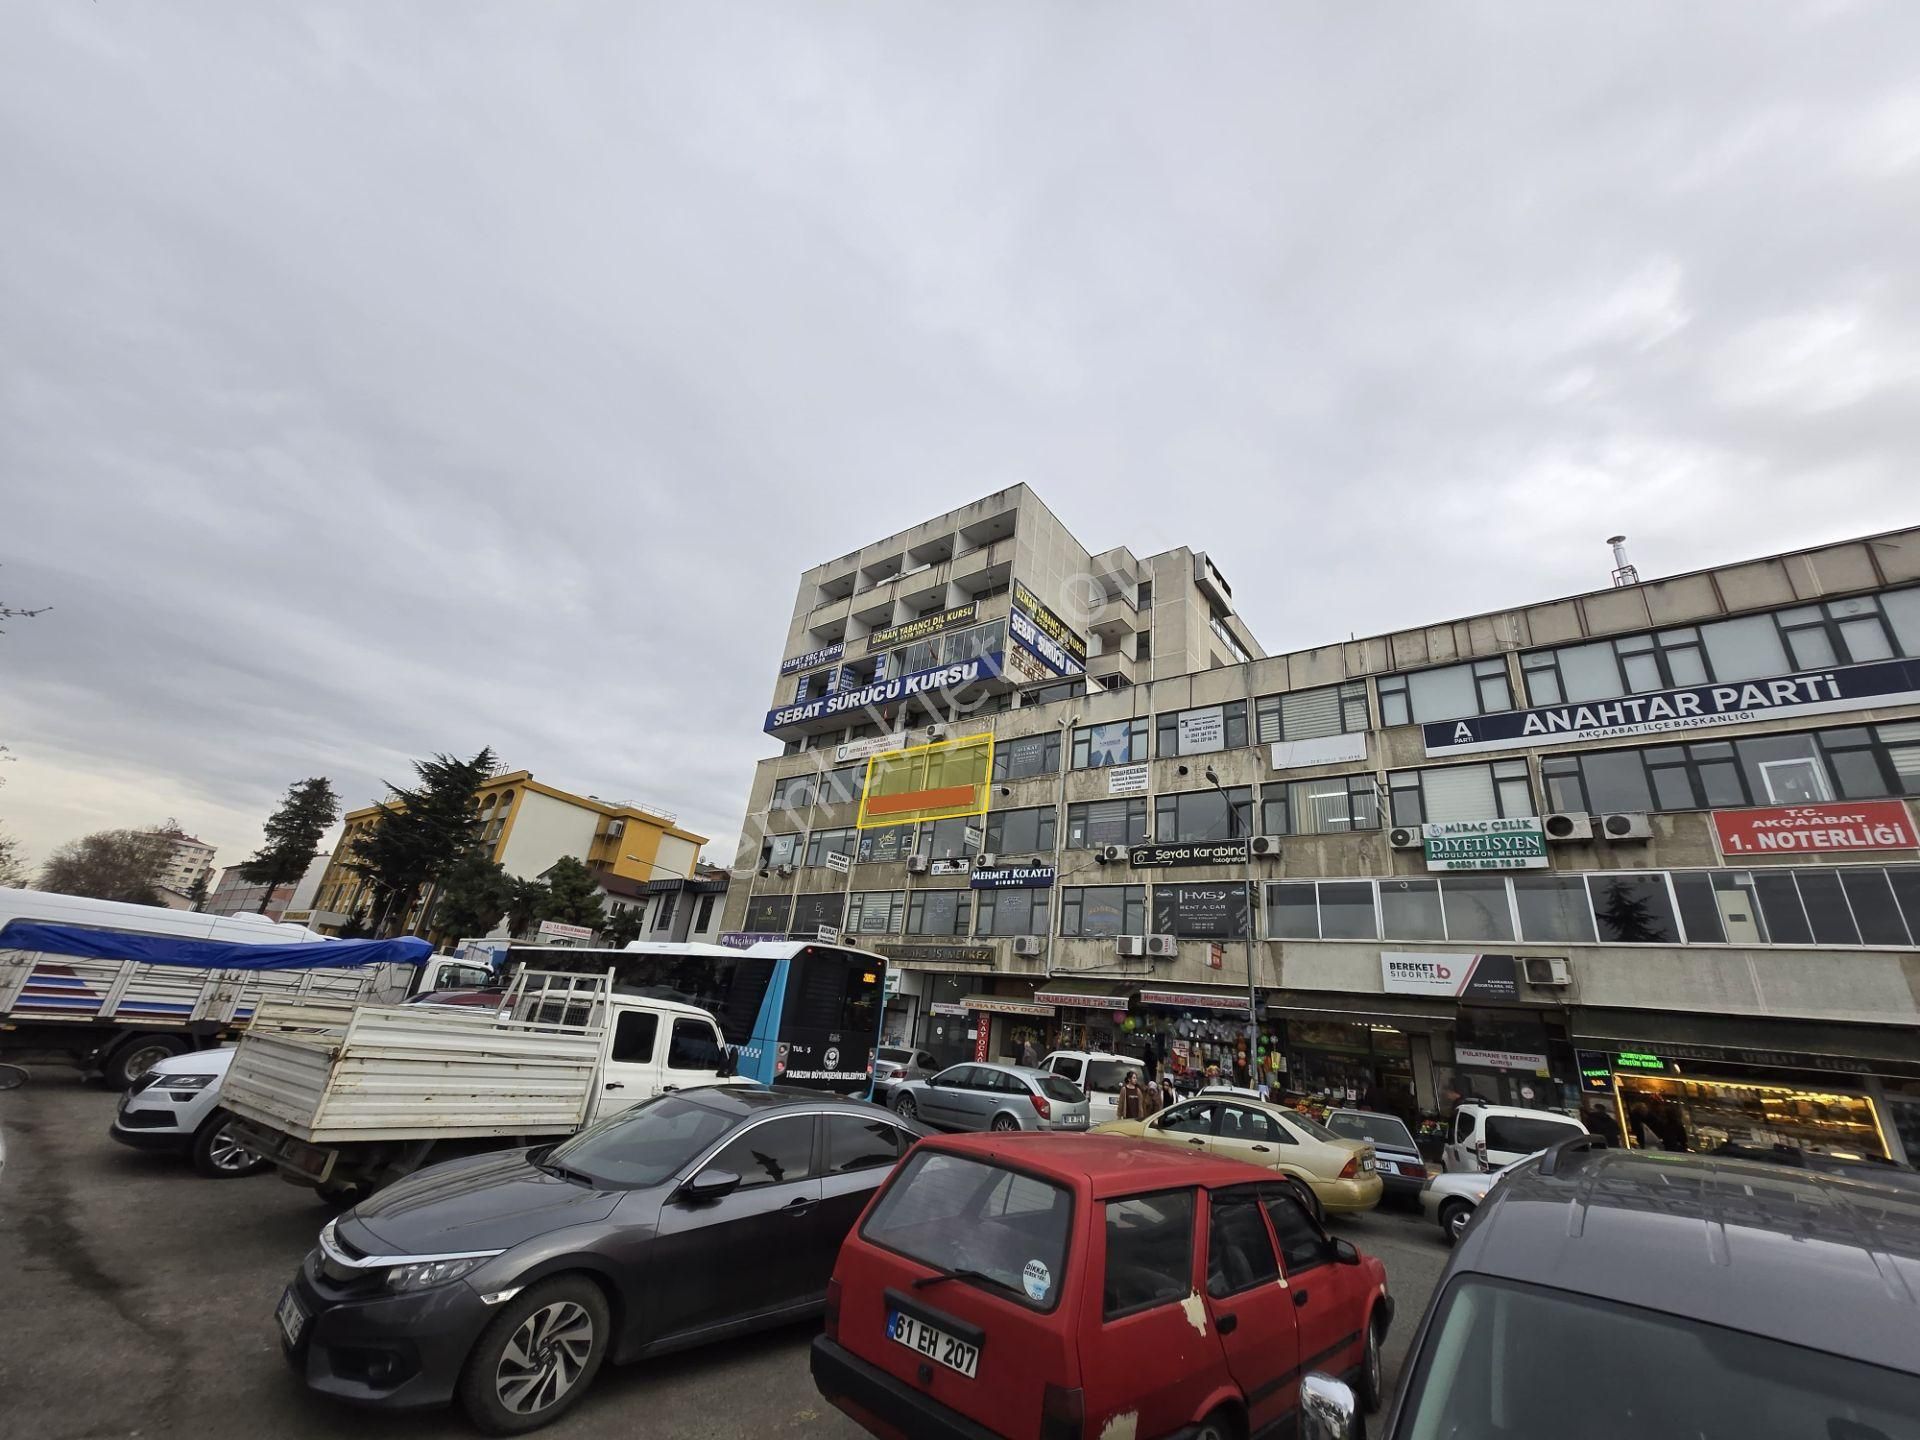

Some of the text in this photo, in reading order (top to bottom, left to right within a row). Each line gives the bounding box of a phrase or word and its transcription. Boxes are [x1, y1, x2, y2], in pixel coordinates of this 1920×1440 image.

[872, 605, 974, 644] UZMAN YABANCI DİL KURSU
[1011, 613, 1036, 646] SEBAT
[783, 657, 804, 670] SEBAT
[819, 643, 843, 658] KURSU
[773, 702, 824, 727] SEBAT
[826, 679, 901, 713] SÜRÜCÜ
[904, 661, 979, 695] KURSU
[1522, 692, 1703, 736] ANAHTAR
[1578, 711, 1756, 740] AKÇAABAT İLÇE BAŞKANLIĞI
[1751, 814, 1867, 829] AKÇAABAT
[1784, 808, 1824, 818] T.C.
[1445, 819, 1533, 834] MİRAÇ ÇELİK
[1430, 835, 1541, 853] DİYETİSYEN
[1729, 823, 1908, 851] 1. NOTERLİĞİ
[1432, 851, 1494, 859] ANDULASYON
[972, 870, 1010, 881] MEHMET
[1185, 891, 1216, 900] HMS
[1389, 962, 1435, 972] BEREKET
[786, 1069, 867, 1081] TRABZON BÜYÜKŞEHİR BELEDİYESİ
[895, 1315, 914, 1345] 61
[917, 1324, 940, 1358] EH
[943, 1337, 977, 1374] 207
